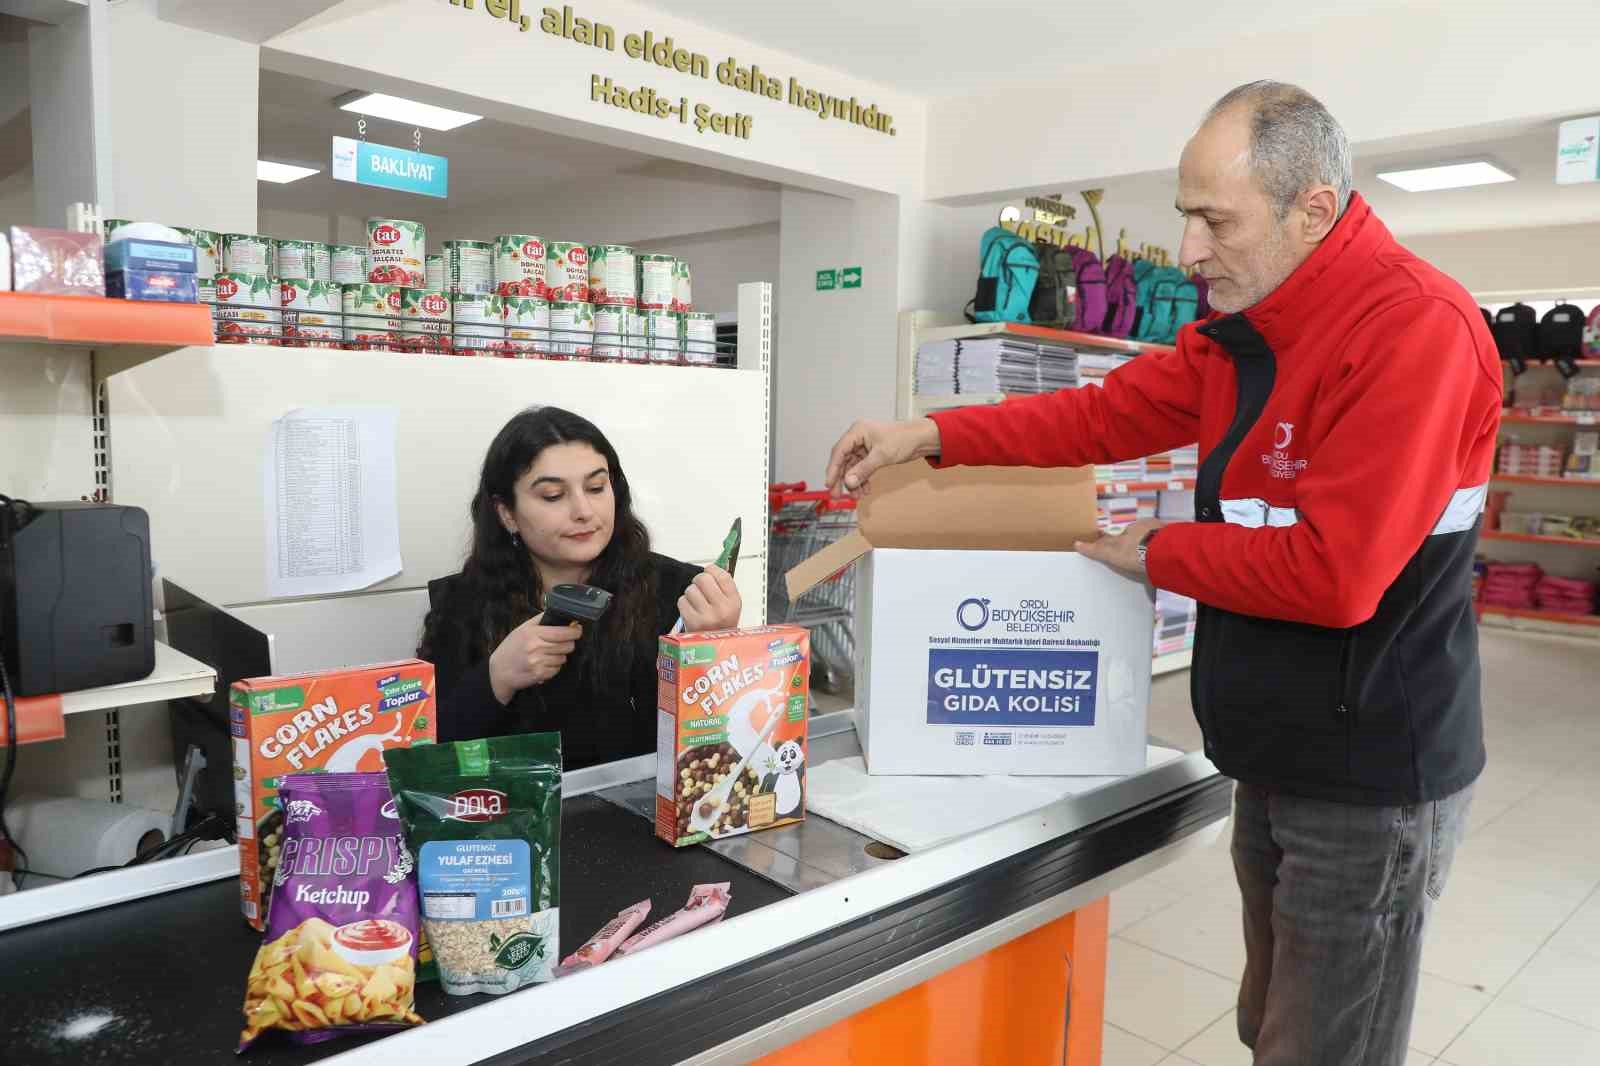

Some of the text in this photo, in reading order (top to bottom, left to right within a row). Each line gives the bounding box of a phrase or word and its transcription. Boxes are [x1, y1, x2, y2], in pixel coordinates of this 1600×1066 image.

[540, 5, 615, 51] alan
[624, 31, 710, 79] elden
[717, 57, 784, 101] daha
[788, 77, 897, 137] hayırlıdır.
[590, 73, 754, 140] Hadis-i Şerif
[370, 154, 435, 181] BAKLİYAT
[376, 228, 398, 241] tat
[991, 609, 1075, 624] BÜYÜKŞEHİR
[1019, 599, 1049, 610] ORDU
[928, 635, 951, 646] Sosyal
[682, 654, 739, 705] CORN
[700, 663, 764, 716] FLAKES
[384, 690, 421, 708] Toplar
[943, 694, 1000, 712] GIDA
[260, 695, 338, 759] CORN
[286, 703, 374, 770] FLAKES
[280, 836, 402, 877] CRISPY
[437, 852, 513, 866] YULAF EZMESİ
[295, 884, 370, 912] Ketchup
